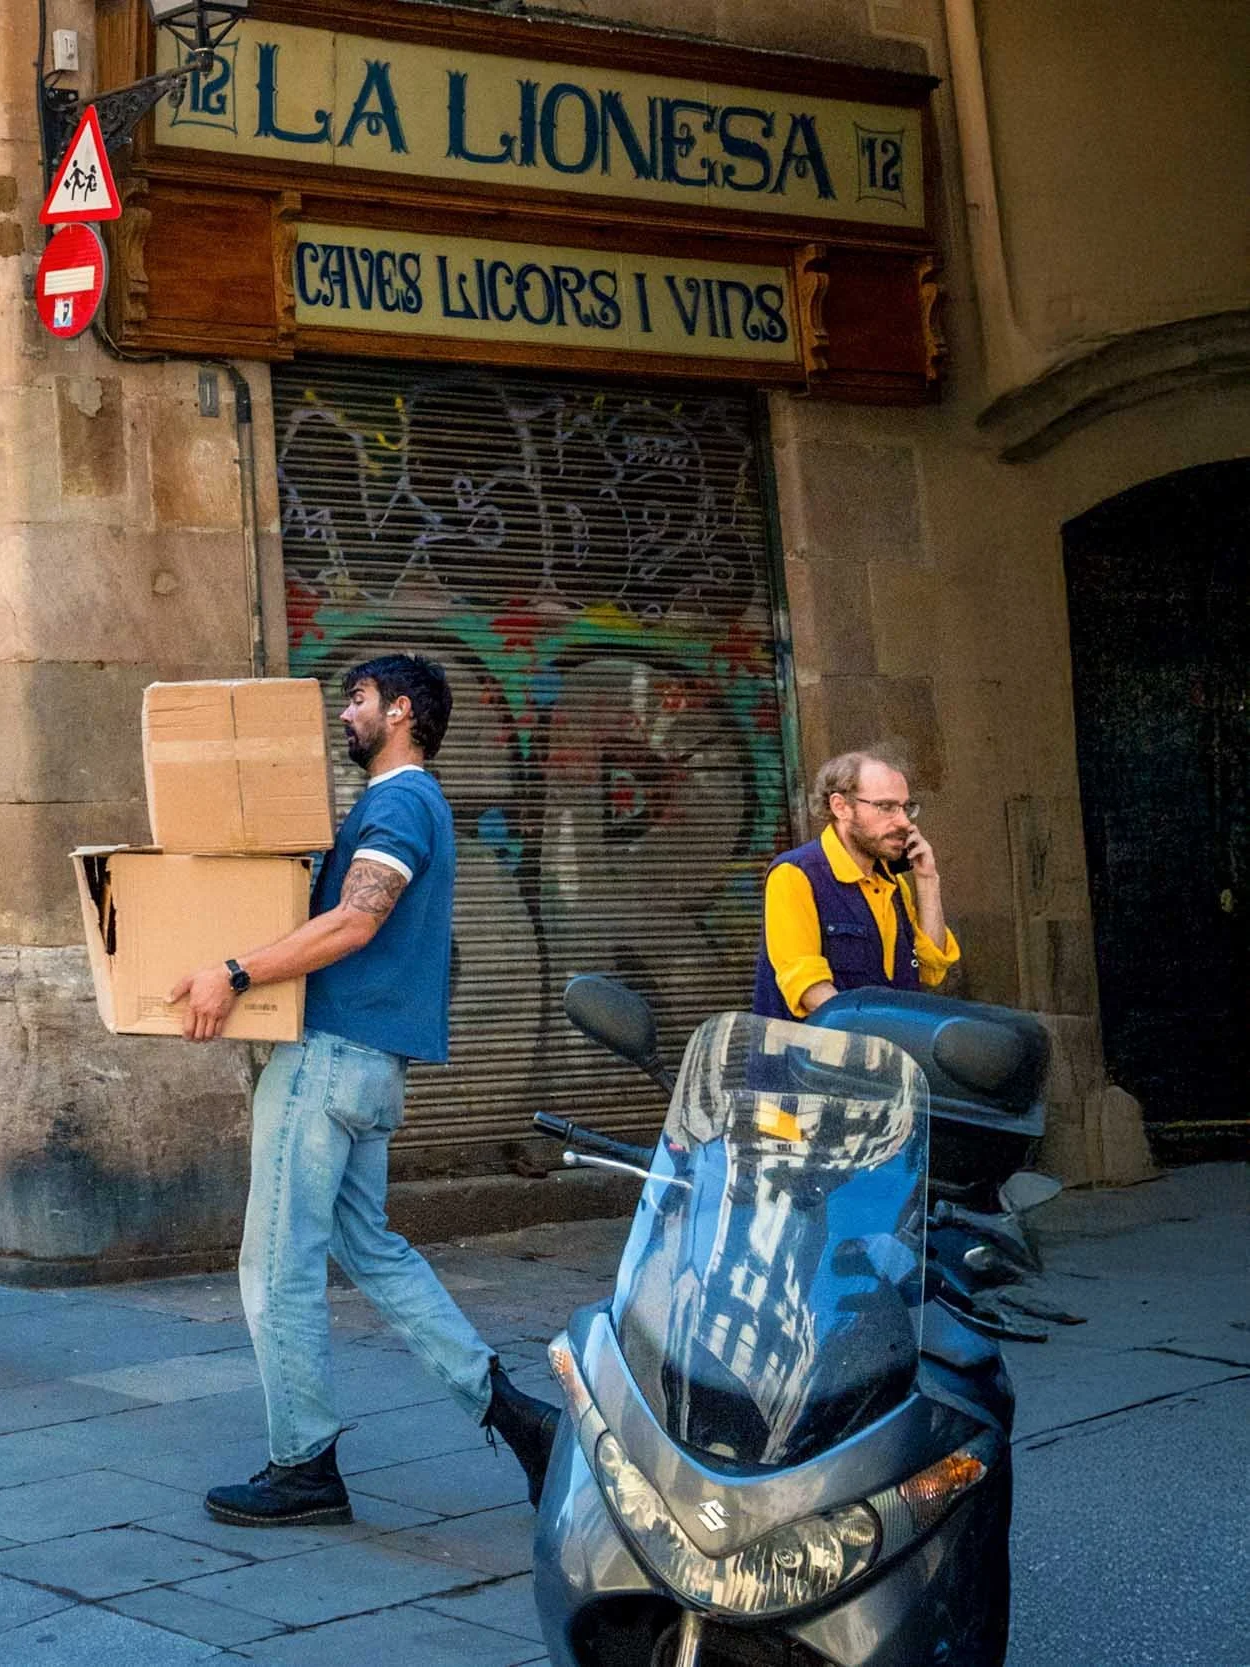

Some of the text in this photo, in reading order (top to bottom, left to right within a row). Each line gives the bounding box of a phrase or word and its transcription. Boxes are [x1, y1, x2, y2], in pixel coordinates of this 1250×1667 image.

[254, 42, 410, 155] LA
[445, 69, 837, 200] LIONESA
[861, 136, 903, 192] 12
[296, 241, 789, 344] CAVES LICORS I VINS
